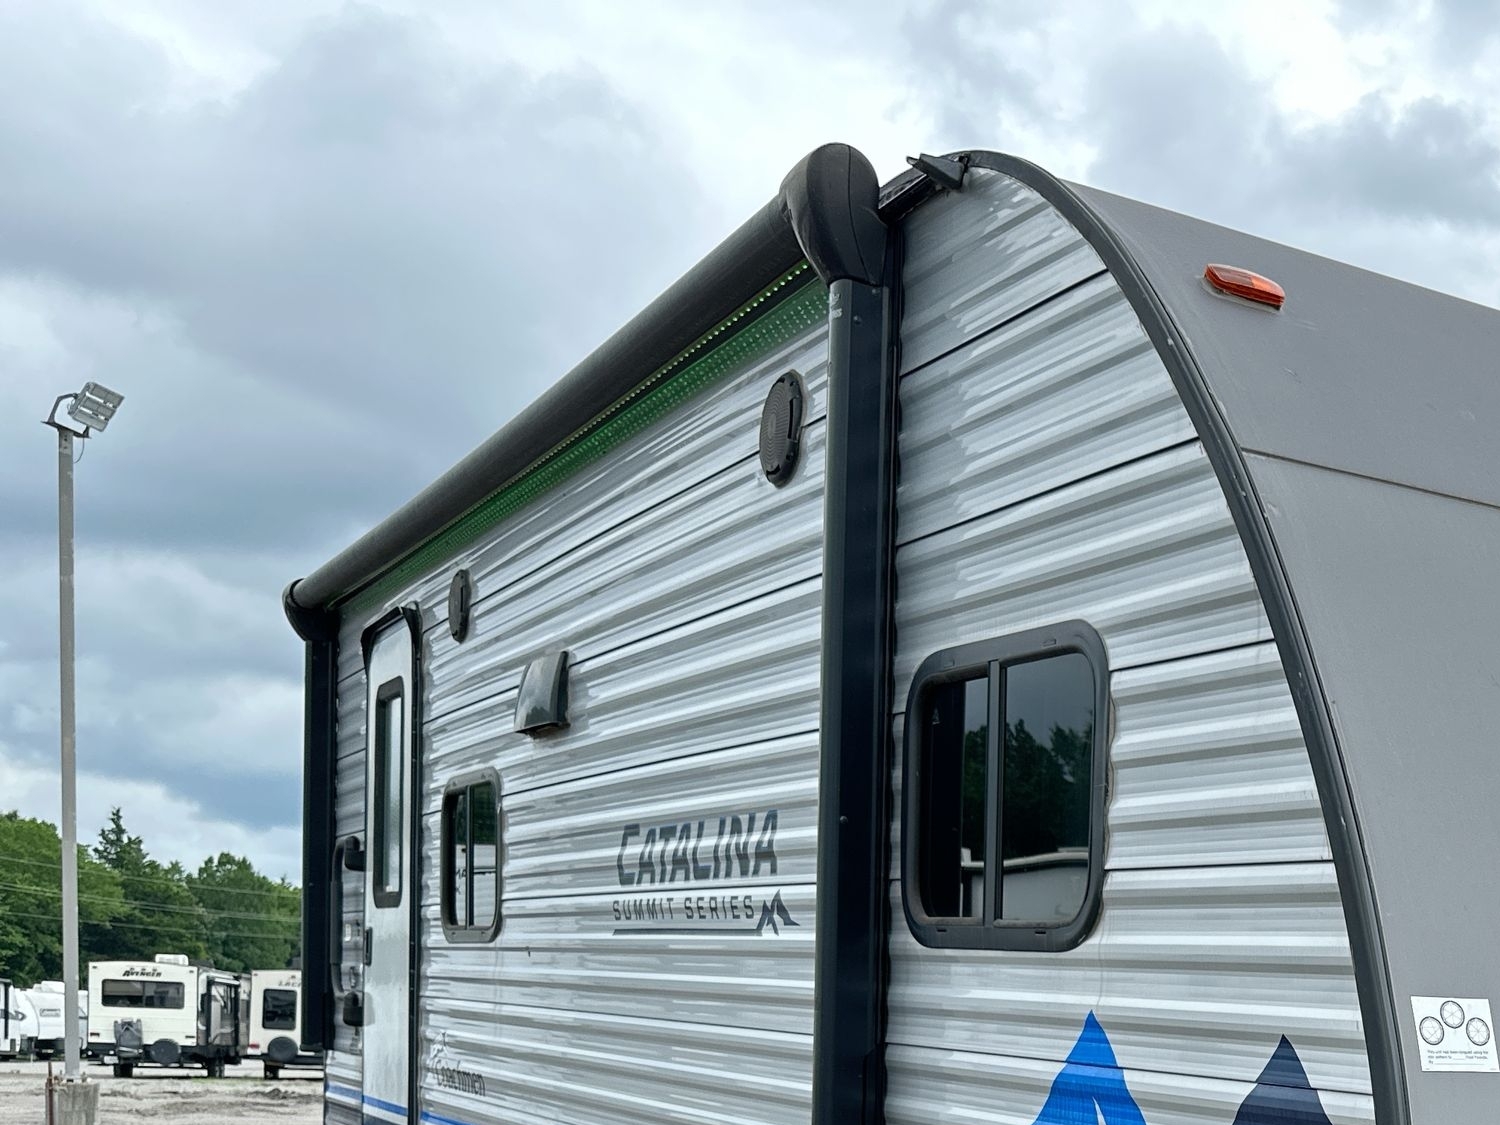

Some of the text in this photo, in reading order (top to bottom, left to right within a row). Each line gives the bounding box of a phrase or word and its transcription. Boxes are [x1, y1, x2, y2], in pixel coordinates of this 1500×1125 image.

[616, 809, 778, 886] CATALINA
[612, 895, 755, 920] SUMMIT SERIES
